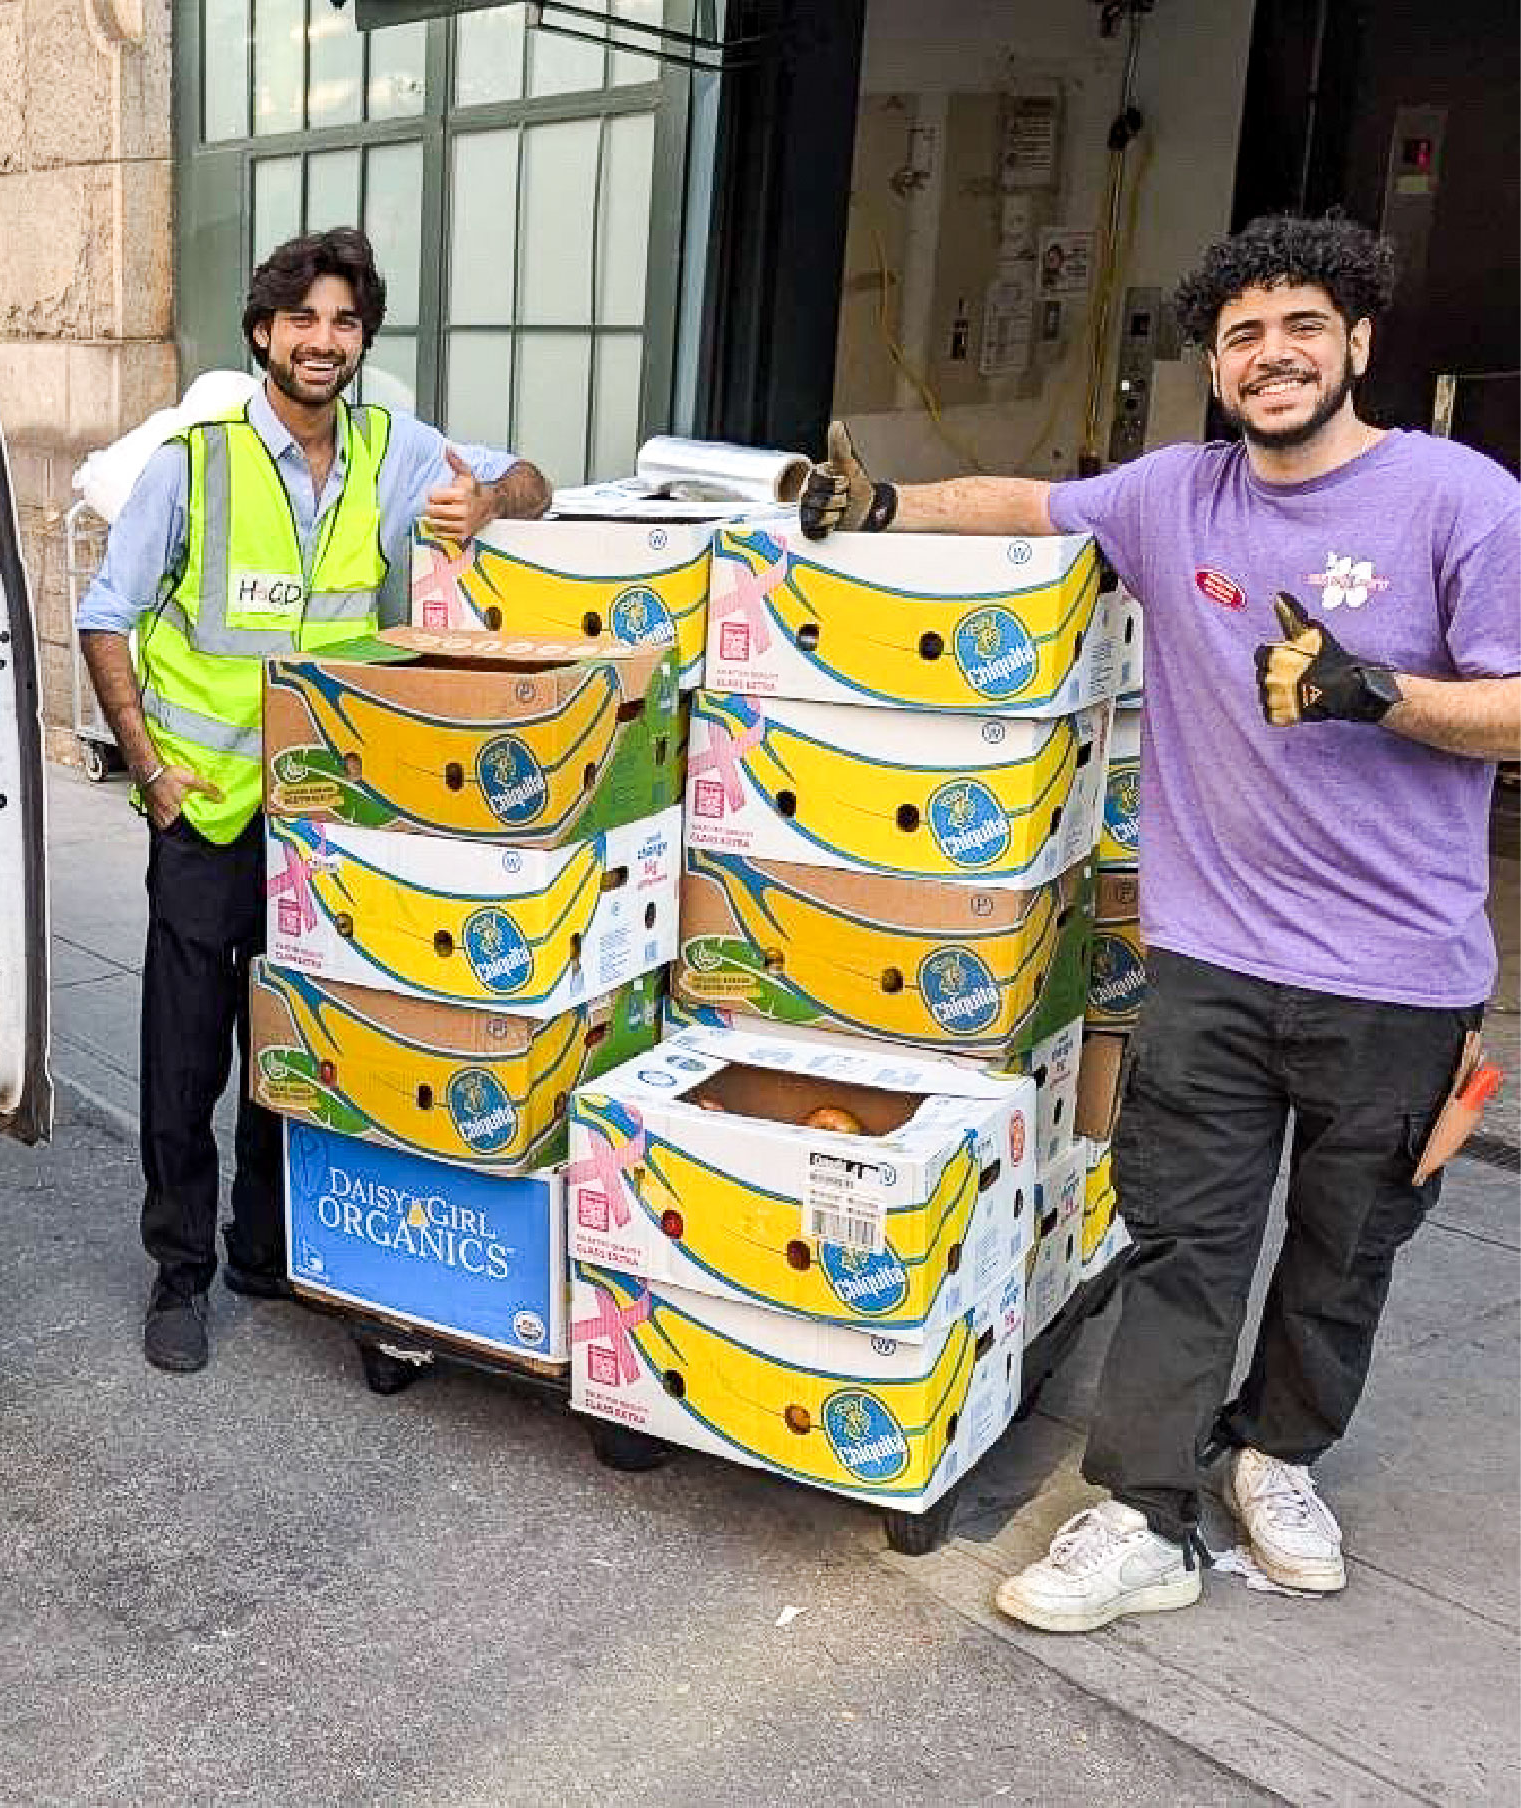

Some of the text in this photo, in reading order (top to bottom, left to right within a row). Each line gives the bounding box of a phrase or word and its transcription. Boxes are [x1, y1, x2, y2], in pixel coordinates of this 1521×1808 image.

[317, 1195, 509, 1279] ORGANICS
[328, 1165, 497, 1242] DAISY GIRL
